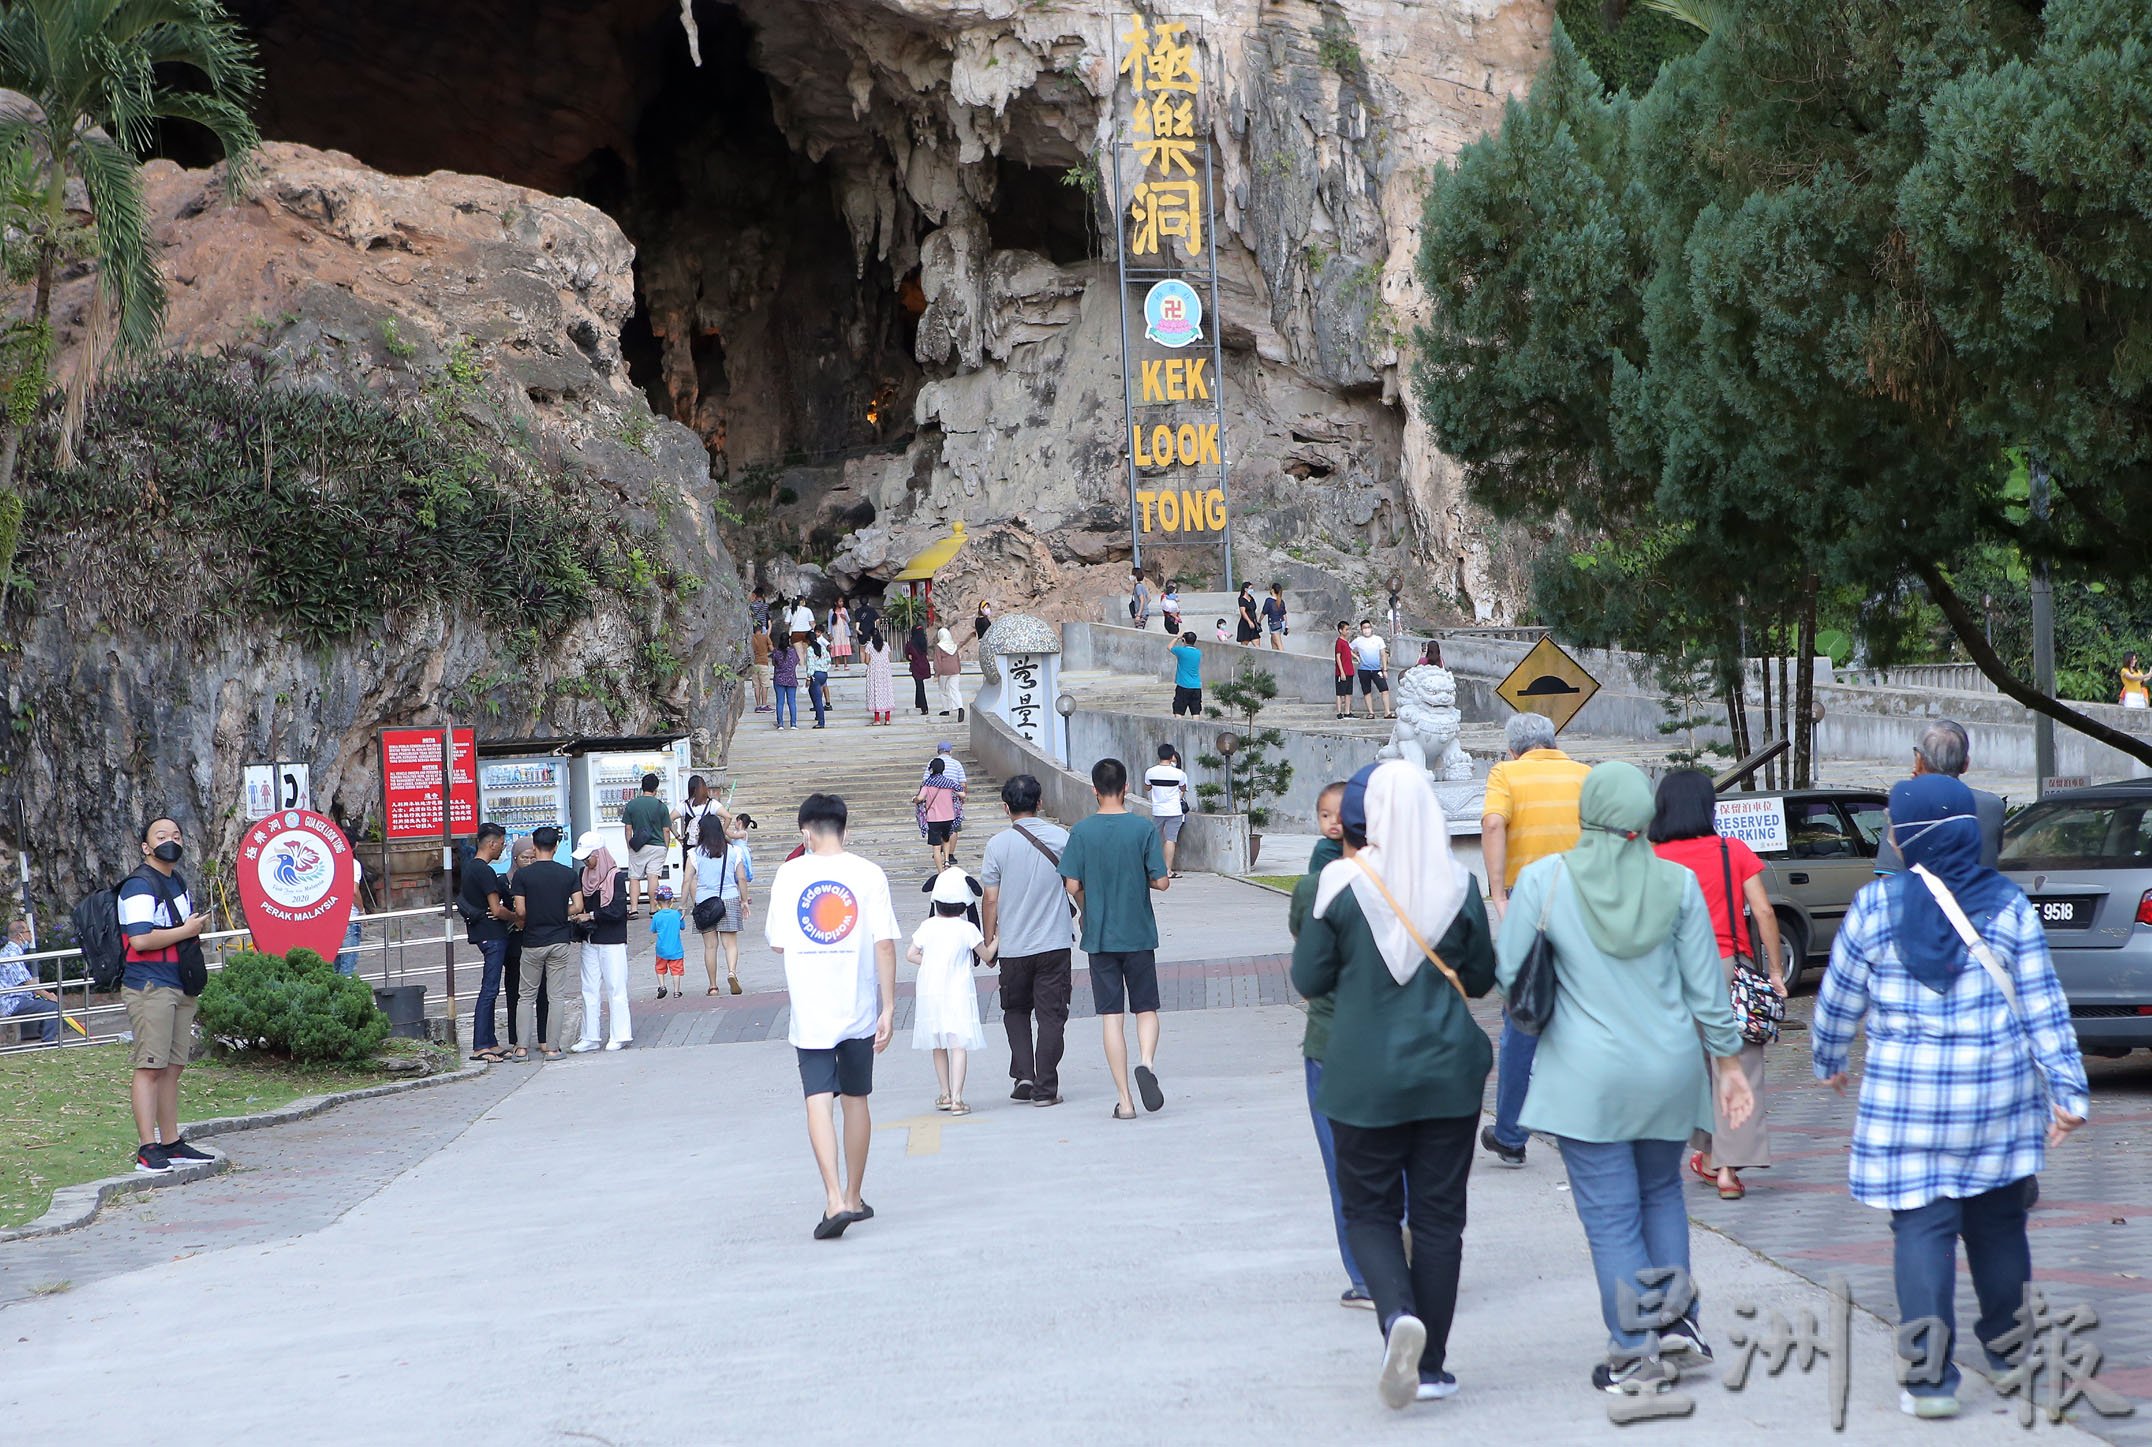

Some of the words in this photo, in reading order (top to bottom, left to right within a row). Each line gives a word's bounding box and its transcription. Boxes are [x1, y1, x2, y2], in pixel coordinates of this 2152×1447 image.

[1120, 14, 1201, 257] 極樂洞
[1141, 358, 1209, 401] KEK
[1133, 423, 1221, 467] LOOK
[1136, 489, 1227, 533] TONG
[1719, 801, 1773, 815] 保留泊車位
[1714, 814, 1780, 830] RESERVED
[1721, 827, 1776, 841] PARKING
[244, 818, 282, 861] 極樂洞
[315, 820, 327, 834] KEK
[322, 826, 338, 843] LOOK
[332, 837, 346, 854] TONG
[260, 900, 293, 921] PERAK
[294, 895, 339, 922] MALAYSIA
[292, 895, 310, 903] 2020
[801, 884, 853, 909] sidewalks
[2043, 902, 2074, 921] 9518
[801, 915, 853, 943] worldwide
